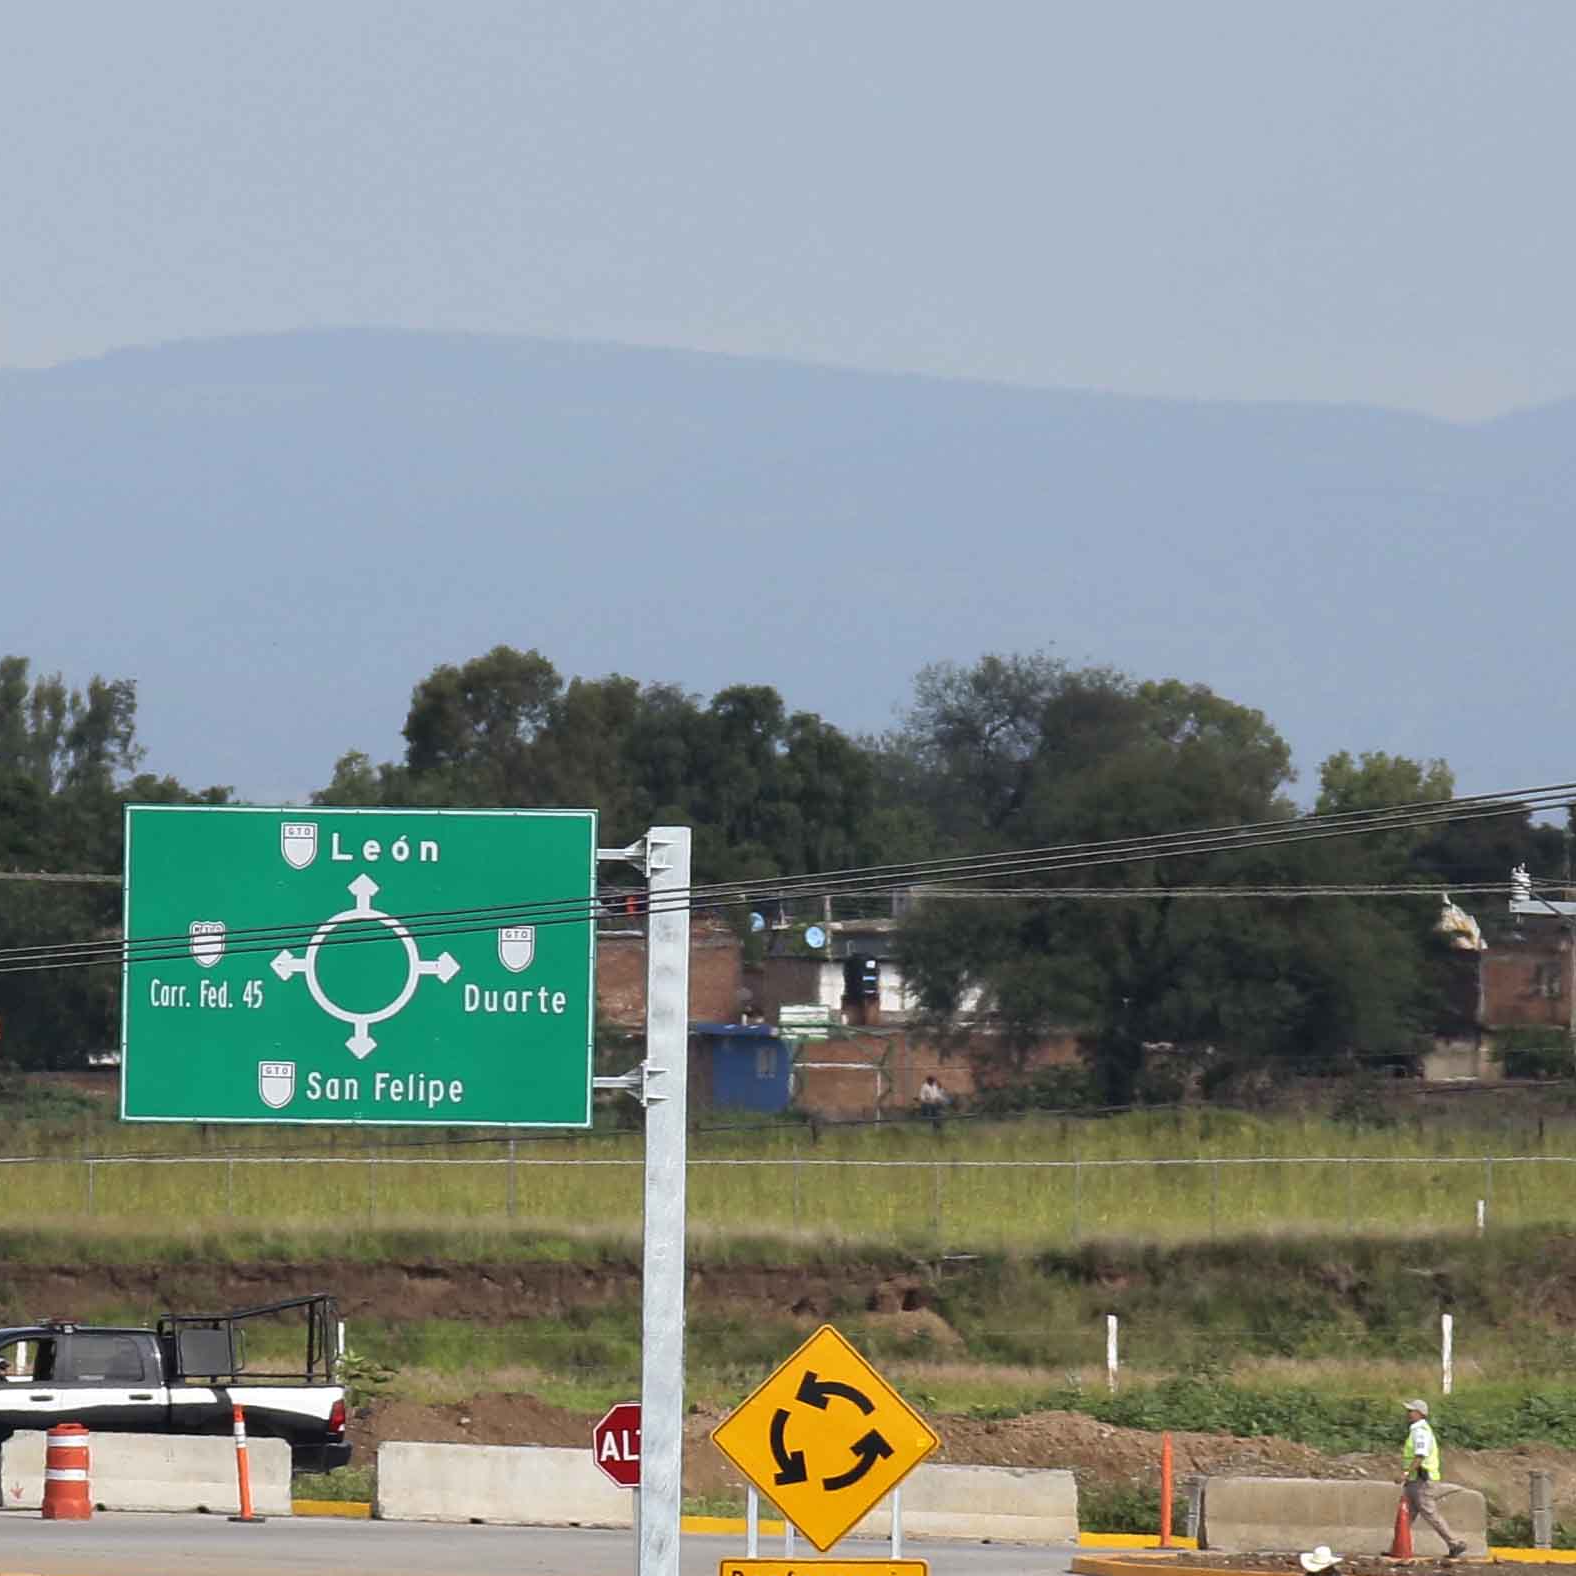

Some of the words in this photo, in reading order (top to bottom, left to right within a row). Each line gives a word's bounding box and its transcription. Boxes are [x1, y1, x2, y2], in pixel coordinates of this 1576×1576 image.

[331, 832, 439, 862] León
[505, 930, 528, 939] GTO
[150, 978, 191, 1008] Carr.
[200, 979, 234, 1009] Fed.
[242, 980, 263, 1010] 45
[464, 984, 566, 1014] Duarte
[265, 1066, 288, 1075] GTO
[306, 1071, 358, 1100] San
[375, 1072, 463, 1109] Felipe
